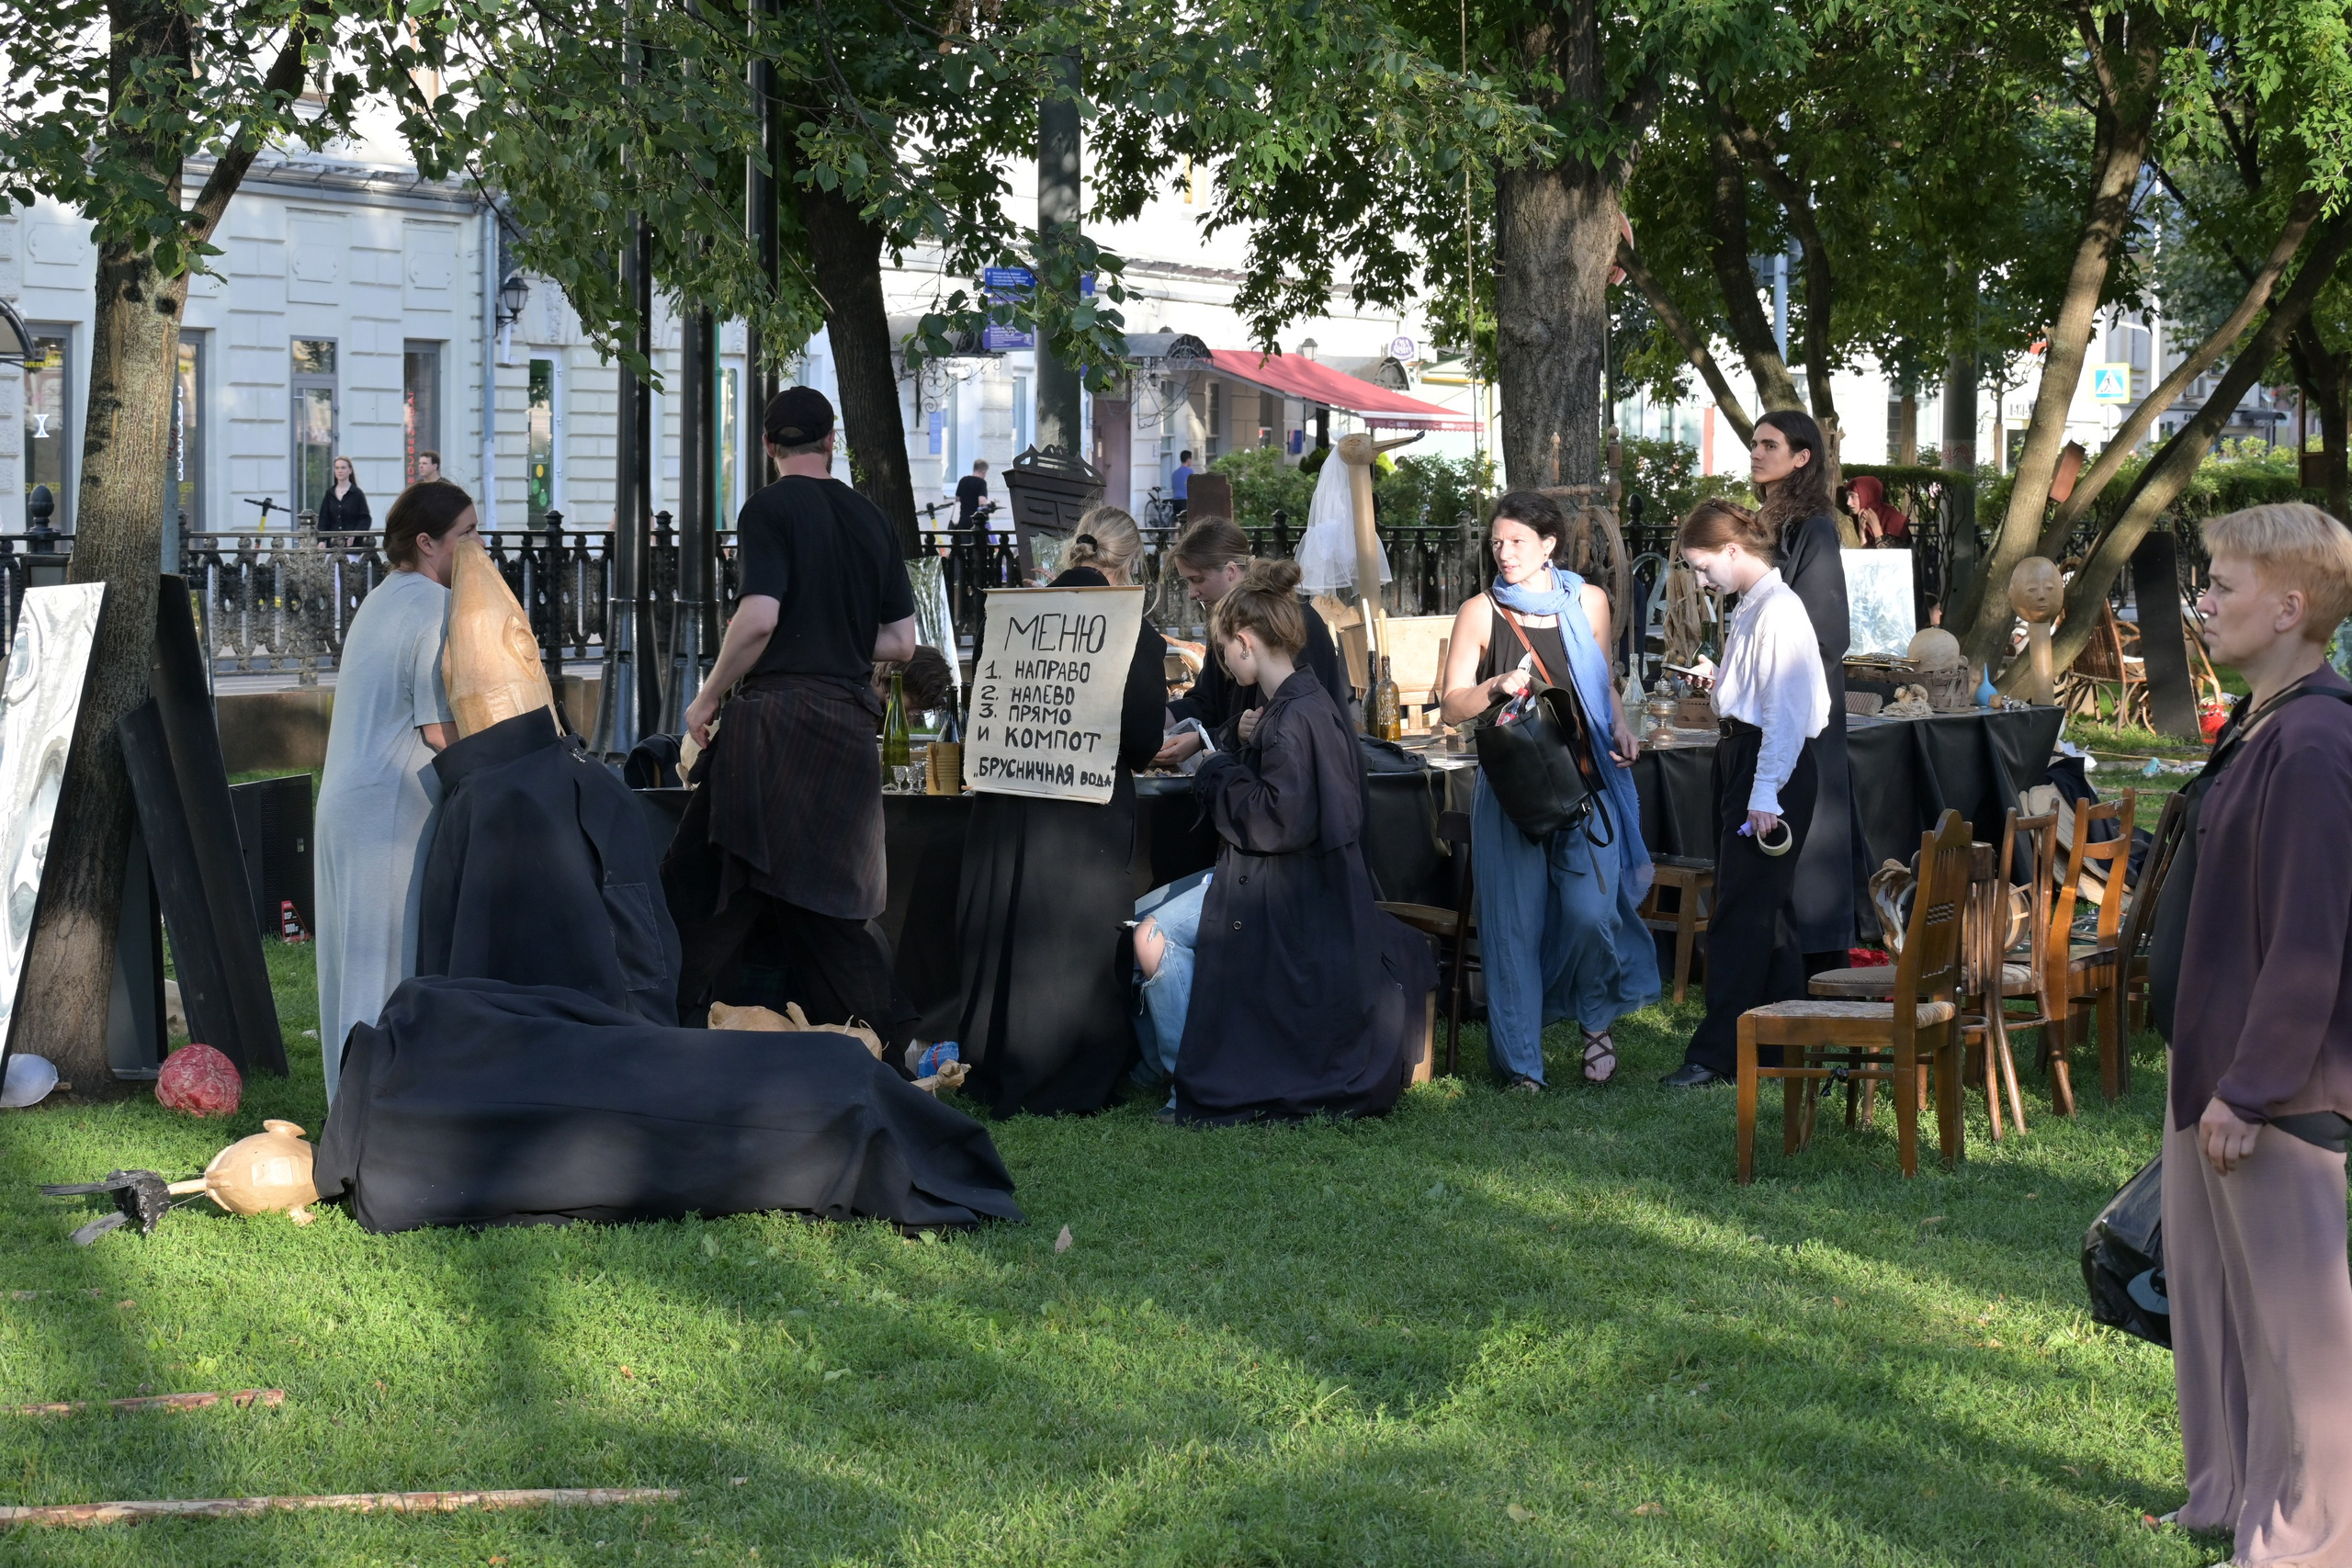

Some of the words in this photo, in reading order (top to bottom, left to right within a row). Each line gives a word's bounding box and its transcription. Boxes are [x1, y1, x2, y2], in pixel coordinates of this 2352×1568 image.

[1004, 613, 1106, 654] МЕНЮ
[985, 660, 1001, 680] 1.
[1015, 660, 1091, 683] НАПРАВО
[981, 684, 999, 702] 2.
[1012, 685, 1075, 705] НАЛЕВО
[978, 703, 997, 719] 3.
[1009, 705, 1072, 725] ПРЯМО
[1004, 726, 1101, 753] КОМПОТ
